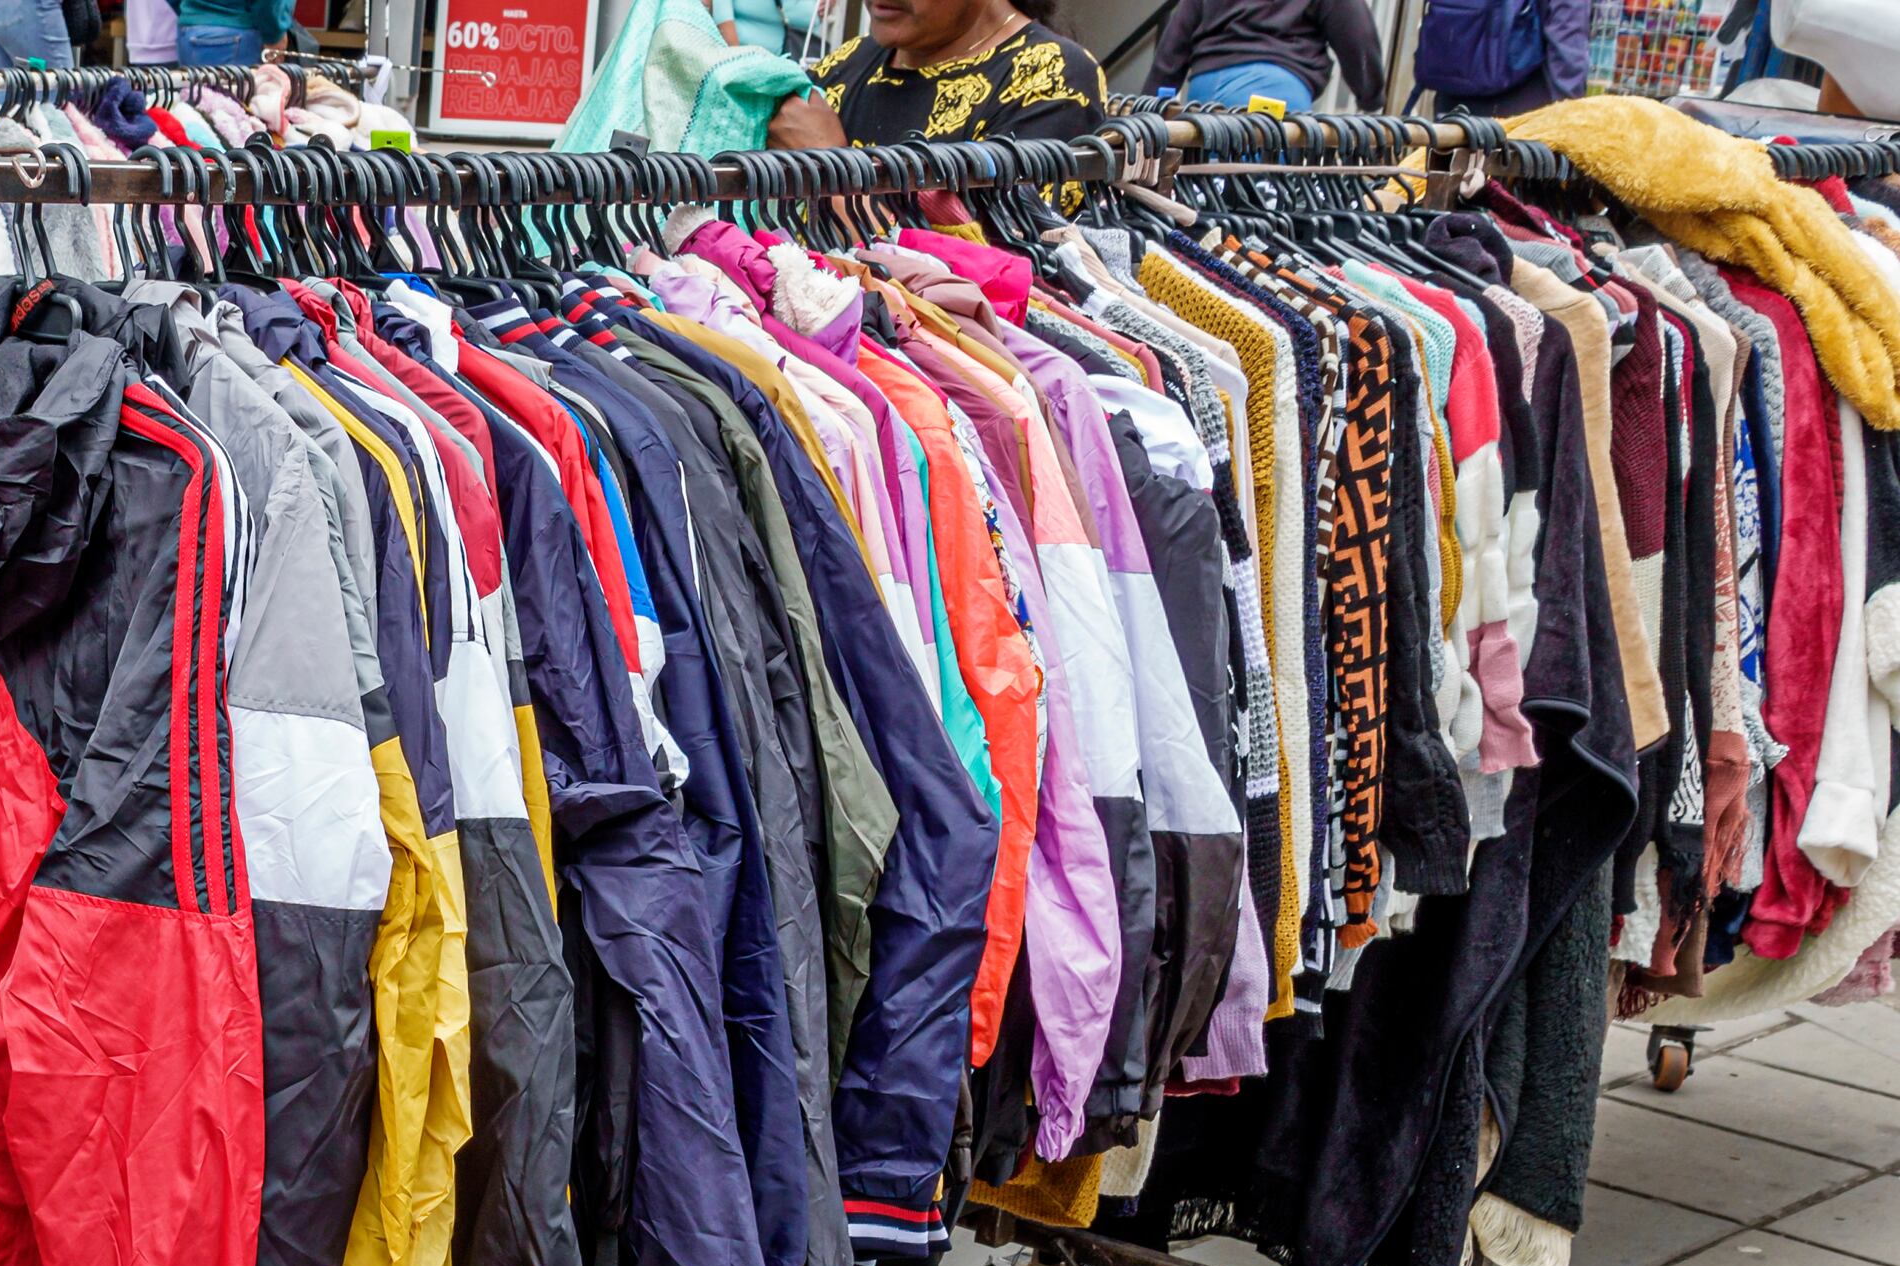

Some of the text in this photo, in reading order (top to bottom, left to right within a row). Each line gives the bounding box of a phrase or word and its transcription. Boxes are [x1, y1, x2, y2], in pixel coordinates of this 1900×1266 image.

[447, 21, 579, 54] 60% DCTO.
[448, 53, 580, 88] REBAJAS
[446, 85, 578, 119] REBAJAS
